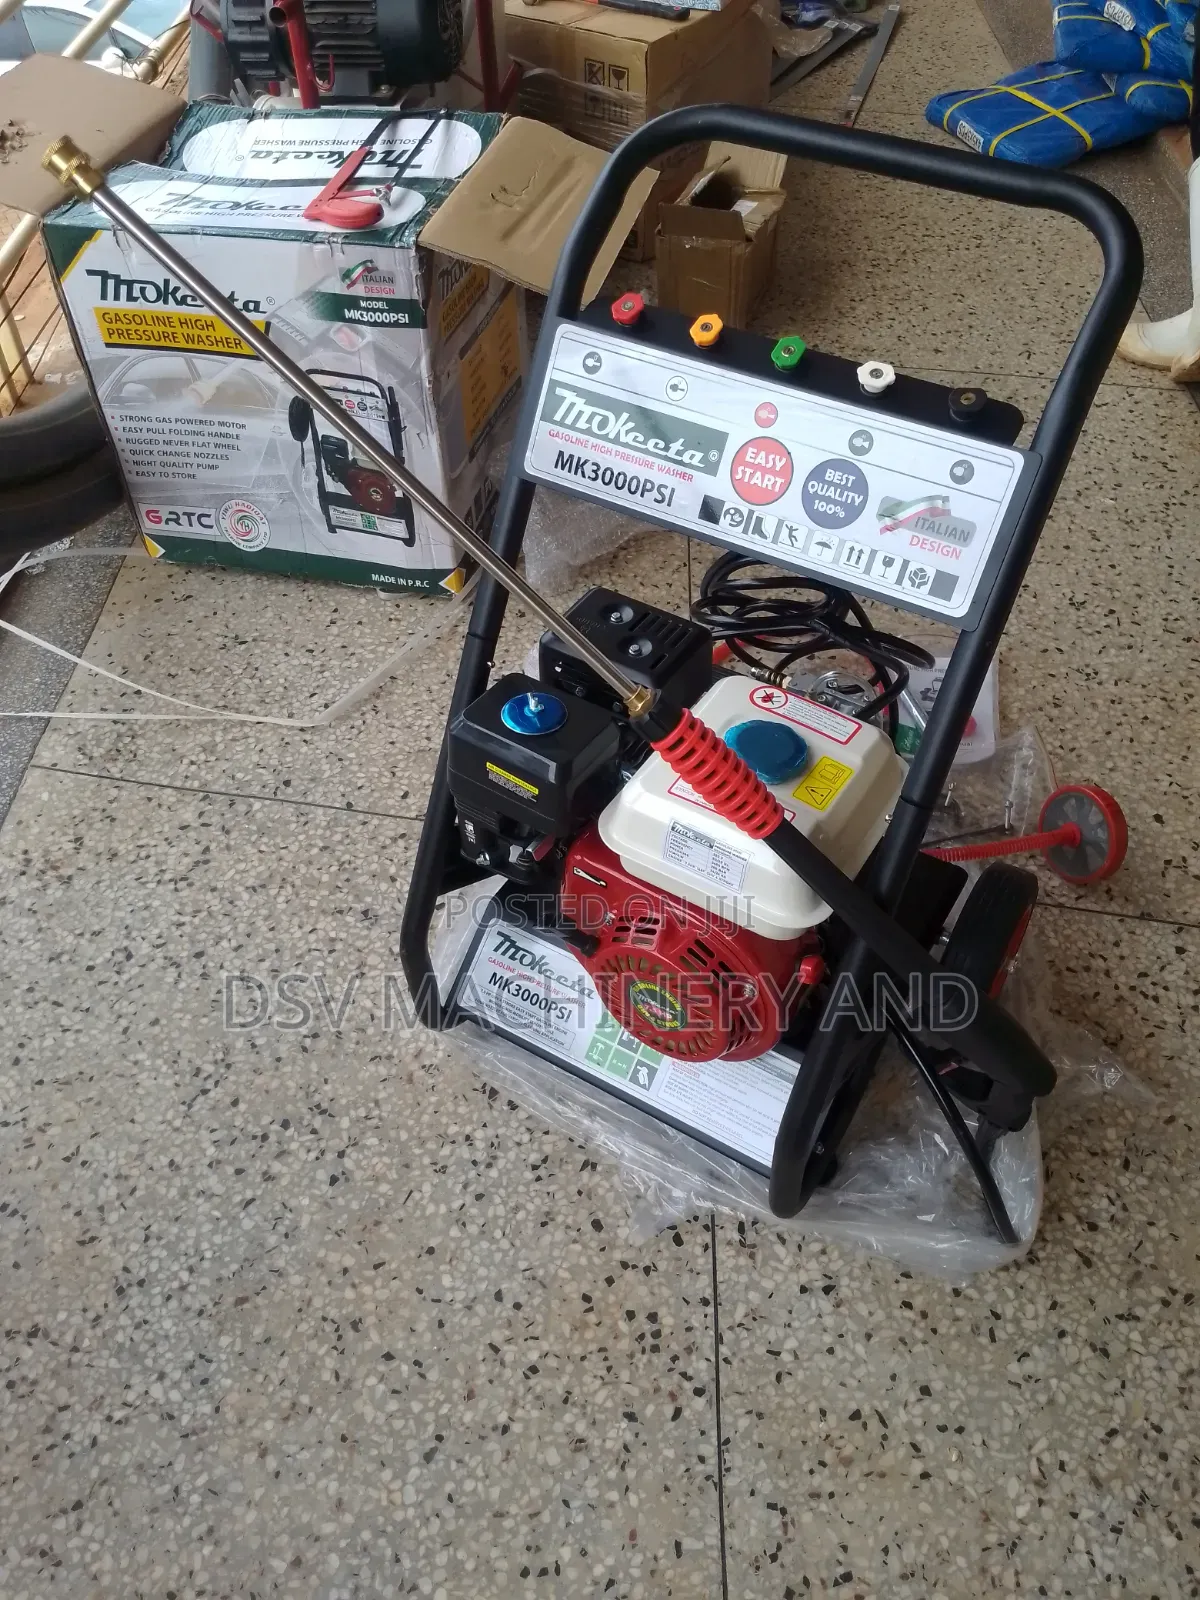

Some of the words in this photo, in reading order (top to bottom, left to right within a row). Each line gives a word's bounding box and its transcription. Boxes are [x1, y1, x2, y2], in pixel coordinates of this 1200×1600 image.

[361, 275, 394, 284] ITALIAN
[364, 286, 395, 295] DESIGN
[360, 300, 388, 309] MODEL
[102, 312, 176, 328] GASOLINE
[179, 317, 216, 332] HIGH
[344, 309, 409, 323] MK3000PSI
[107, 328, 180, 343] PRESSURE
[182, 333, 244, 350] WASHER
[120, 415, 153, 423] STRONG
[156, 416, 172, 424] GAS
[175, 418, 216, 427] POWERED
[218, 421, 247, 430] MOTOR
[122, 426, 144, 434] EASY
[169, 429, 205, 437] FOLDING
[208, 432, 240, 440] HANDLE
[126, 438, 160, 446] RUGGED
[162, 438, 190, 447] NEVER
[192, 441, 211, 449] FLAT
[214, 442, 241, 451] WHEEL
[130, 449, 155, 457] QUICK
[157, 450, 191, 458] CHANGE
[194, 452, 230, 460] NOZZLES
[548, 429, 590, 449] GASOLINE
[591, 443, 612, 456] HIGH
[614, 449, 655, 470] PRESSURE
[658, 463, 694, 483] WASHER
[745, 447, 786, 472] EASY
[160, 460, 194, 469] QUALITY
[197, 462, 220, 470] PUMP
[136, 470, 156, 478] EASY
[172, 472, 197, 480] STORE
[554, 450, 676, 507] MK3000PSI
[735, 465, 785, 493] START
[824, 468, 856, 488] BEST
[807, 480, 864, 507] QUALITY
[813, 500, 846, 518] 100%
[145, 509, 214, 529] GRTC
[914, 515, 971, 543] ITALIAN
[908, 534, 962, 560] DESIGN
[371, 573, 396, 584] MADE
[398, 577, 407, 586] IN
[408, 579, 430, 588] P.R.C
[487, 956, 517, 974] GASOLINE
[488, 971, 572, 1023] MK3000PSI
